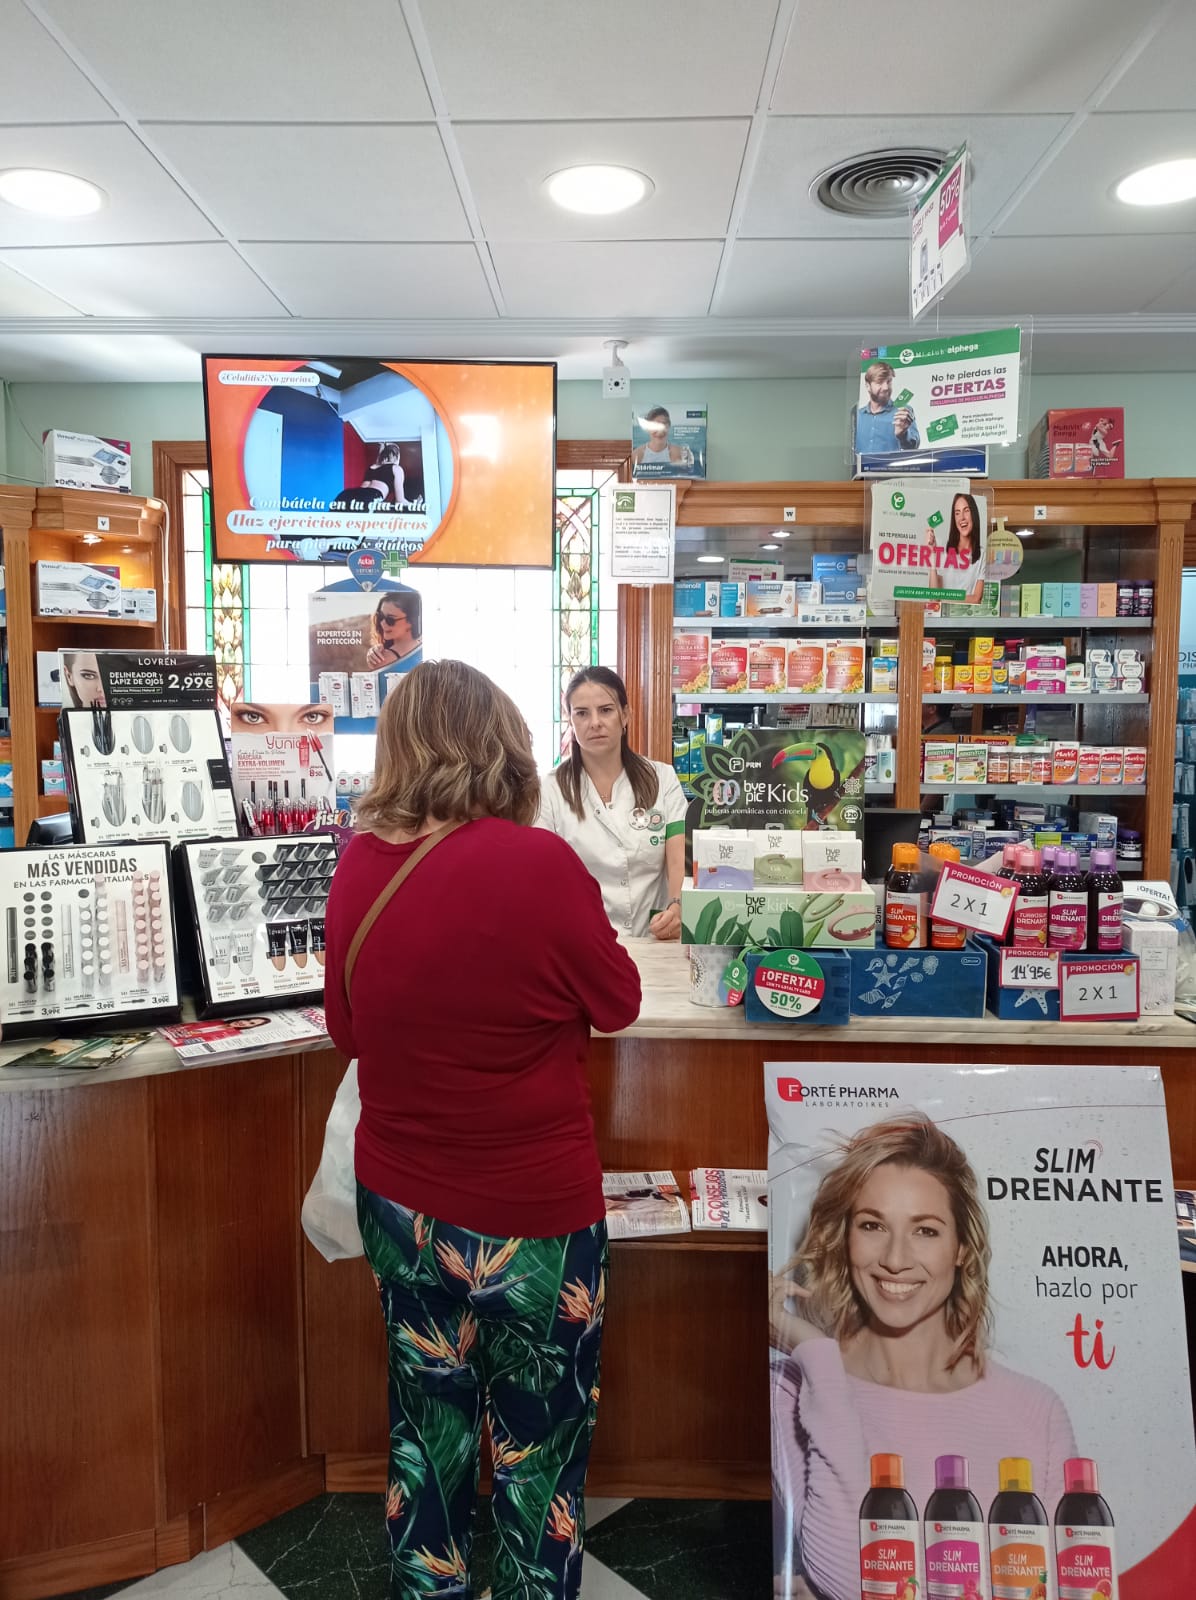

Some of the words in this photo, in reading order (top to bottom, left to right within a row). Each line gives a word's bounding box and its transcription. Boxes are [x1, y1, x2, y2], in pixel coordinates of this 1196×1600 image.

[947, 343, 978, 354] alphega
[931, 374, 944, 382] No
[946, 372, 955, 380] te
[958, 368, 991, 380] pierdas
[994, 366, 1006, 374] las
[931, 378, 1006, 397] OFERTAS
[250, 496, 326, 510] Combátela
[328, 500, 348, 510] en
[350, 498, 365, 510] tu
[232, 514, 264, 527] Haz
[268, 516, 342, 530] ejercicios
[346, 516, 428, 533] específicos
[266, 539, 300, 552] para
[878, 542, 971, 570] OFERTAS
[317, 637, 362, 645] PROTECCIÓN
[138, 656, 177, 666] LOVRÉN
[168, 674, 214, 690] 2,99€
[744, 780, 766, 792] bye
[768, 782, 809, 803] Kids
[745, 792, 763, 805] pic
[704, 808, 730, 816] pulseras
[48, 852, 66, 860] LAS
[68, 850, 117, 860] MÁSCARAS
[28, 860, 60, 879] MÁS
[65, 858, 138, 876] VENDIDAS
[14, 881, 28, 889] EN
[30, 880, 47, 888] LAS
[50, 876, 96, 886] FARMACIA
[951, 870, 1002, 889] PROMOCIÓN
[1137, 885, 1170, 901] ¡OFERTA!
[746, 894, 766, 906] bye
[950, 894, 960, 908] 2
[964, 897, 976, 912] X
[979, 902, 987, 916] 1
[748, 905, 763, 917] pic
[1052, 914, 1086, 922] DRENANTE
[1070, 962, 1123, 972] PROMOCIÓN
[762, 971, 818, 990] ¡OFERTA!
[1079, 988, 1088, 1001] 2
[1093, 986, 1103, 1000] X
[1109, 986, 1117, 999] 1
[770, 992, 802, 1010] 50%
[788, 1084, 836, 1099] FORTÉ
[840, 1086, 899, 1099] PHARMA
[1034, 1148, 1096, 1173] SLIM
[987, 1177, 1163, 1202] DRENANTE
[1042, 1246, 1128, 1271] AHORA,
[1036, 1276, 1092, 1298] hazlo
[1102, 1283, 1138, 1304] por
[1066, 1313, 1116, 1370] ti
[878, 1549, 897, 1560] SLIM
[943, 1550, 962, 1560] SLIM
[1008, 1554, 1027, 1564] SLIM
[1075, 1555, 1094, 1565] SLIM
[864, 1560, 914, 1571] DRENANTE
[929, 1562, 979, 1573] DRENANTE
[994, 1566, 1044, 1577] DRENANTE
[1060, 1566, 1110, 1578] DRENANTE
